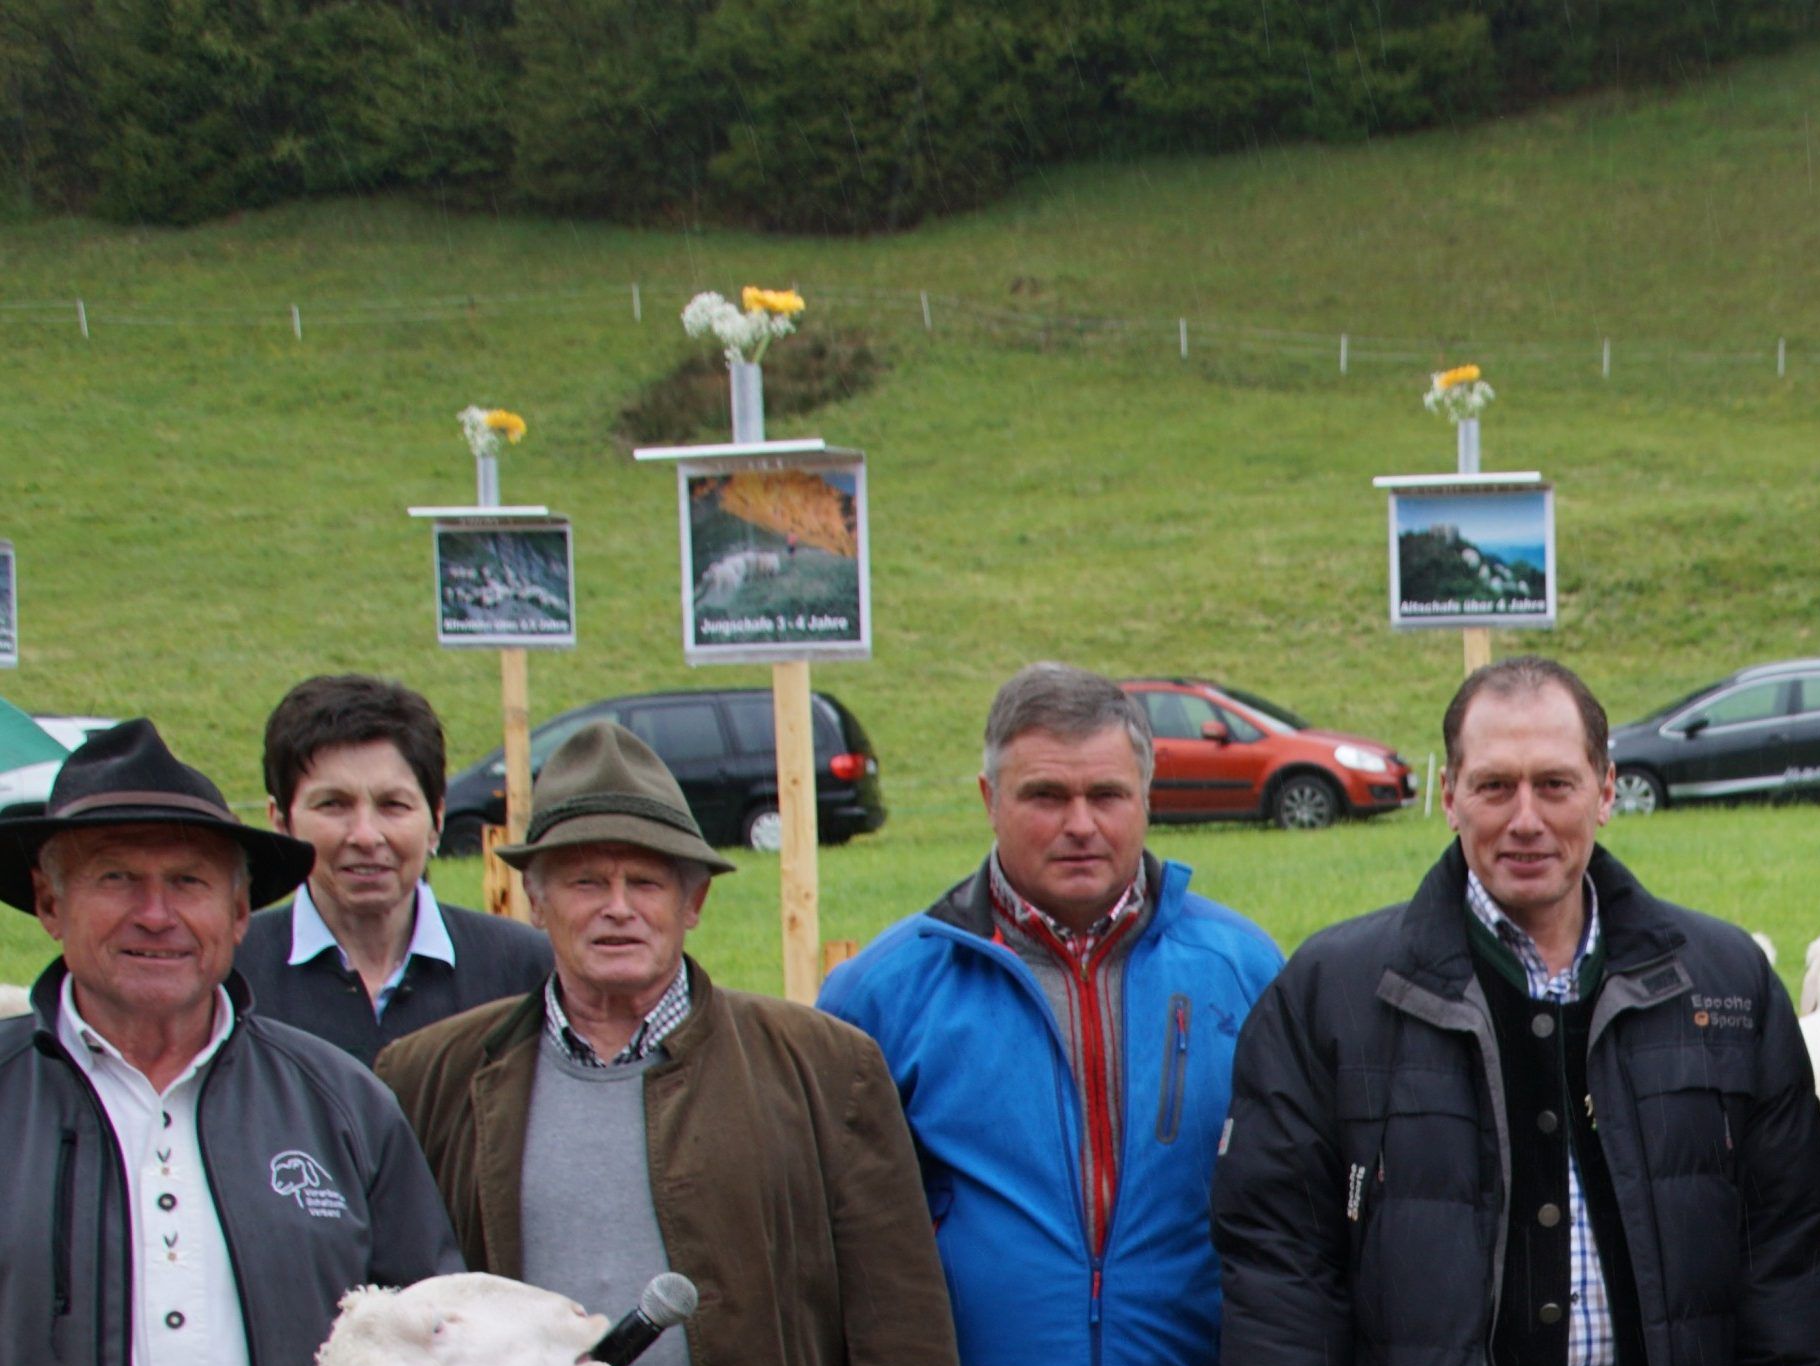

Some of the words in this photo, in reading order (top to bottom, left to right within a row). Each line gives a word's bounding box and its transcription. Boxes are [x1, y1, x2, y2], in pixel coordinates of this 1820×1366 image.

[1507, 598, 1546, 612] Jahre
[700, 616, 775, 636] Jungschafe
[776, 614, 787, 630] 3
[795, 614, 805, 630] 4
[807, 614, 849, 631] Jahre
[1710, 1012, 1754, 1030] Sports
